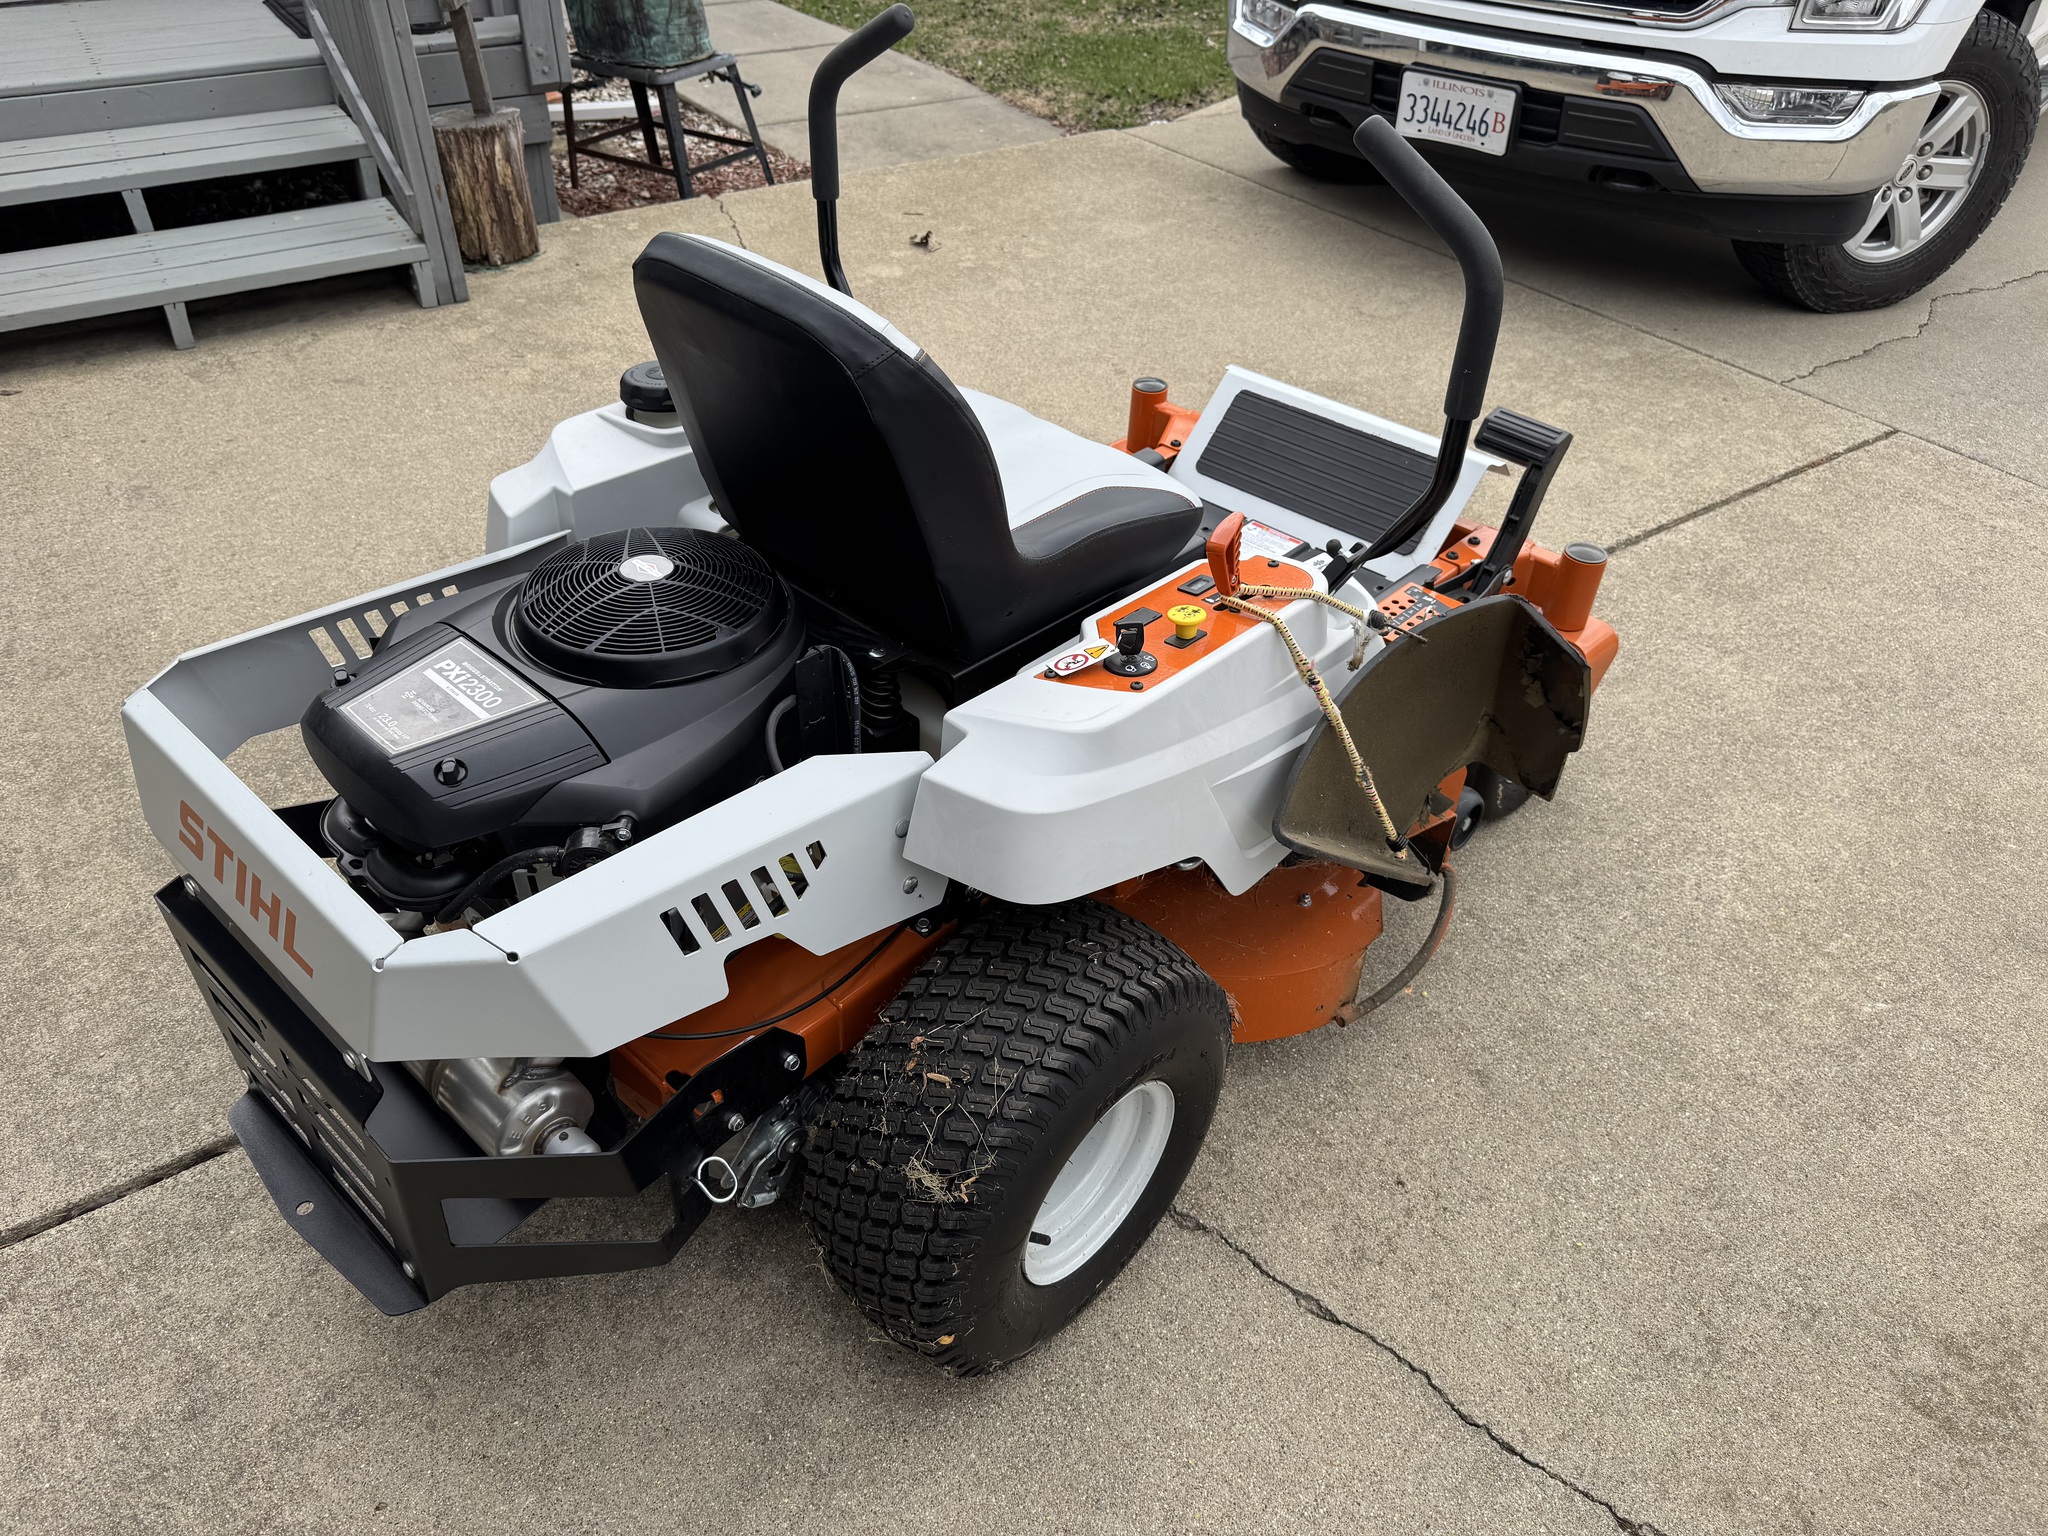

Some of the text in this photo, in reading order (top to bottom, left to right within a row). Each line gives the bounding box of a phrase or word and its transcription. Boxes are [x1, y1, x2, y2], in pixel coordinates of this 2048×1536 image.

[1432, 79, 1486, 98] ILLINOIS
[1402, 93, 1490, 137] 3344246
[433, 659, 503, 708] PXi2300
[178, 799, 314, 979] STIHL
